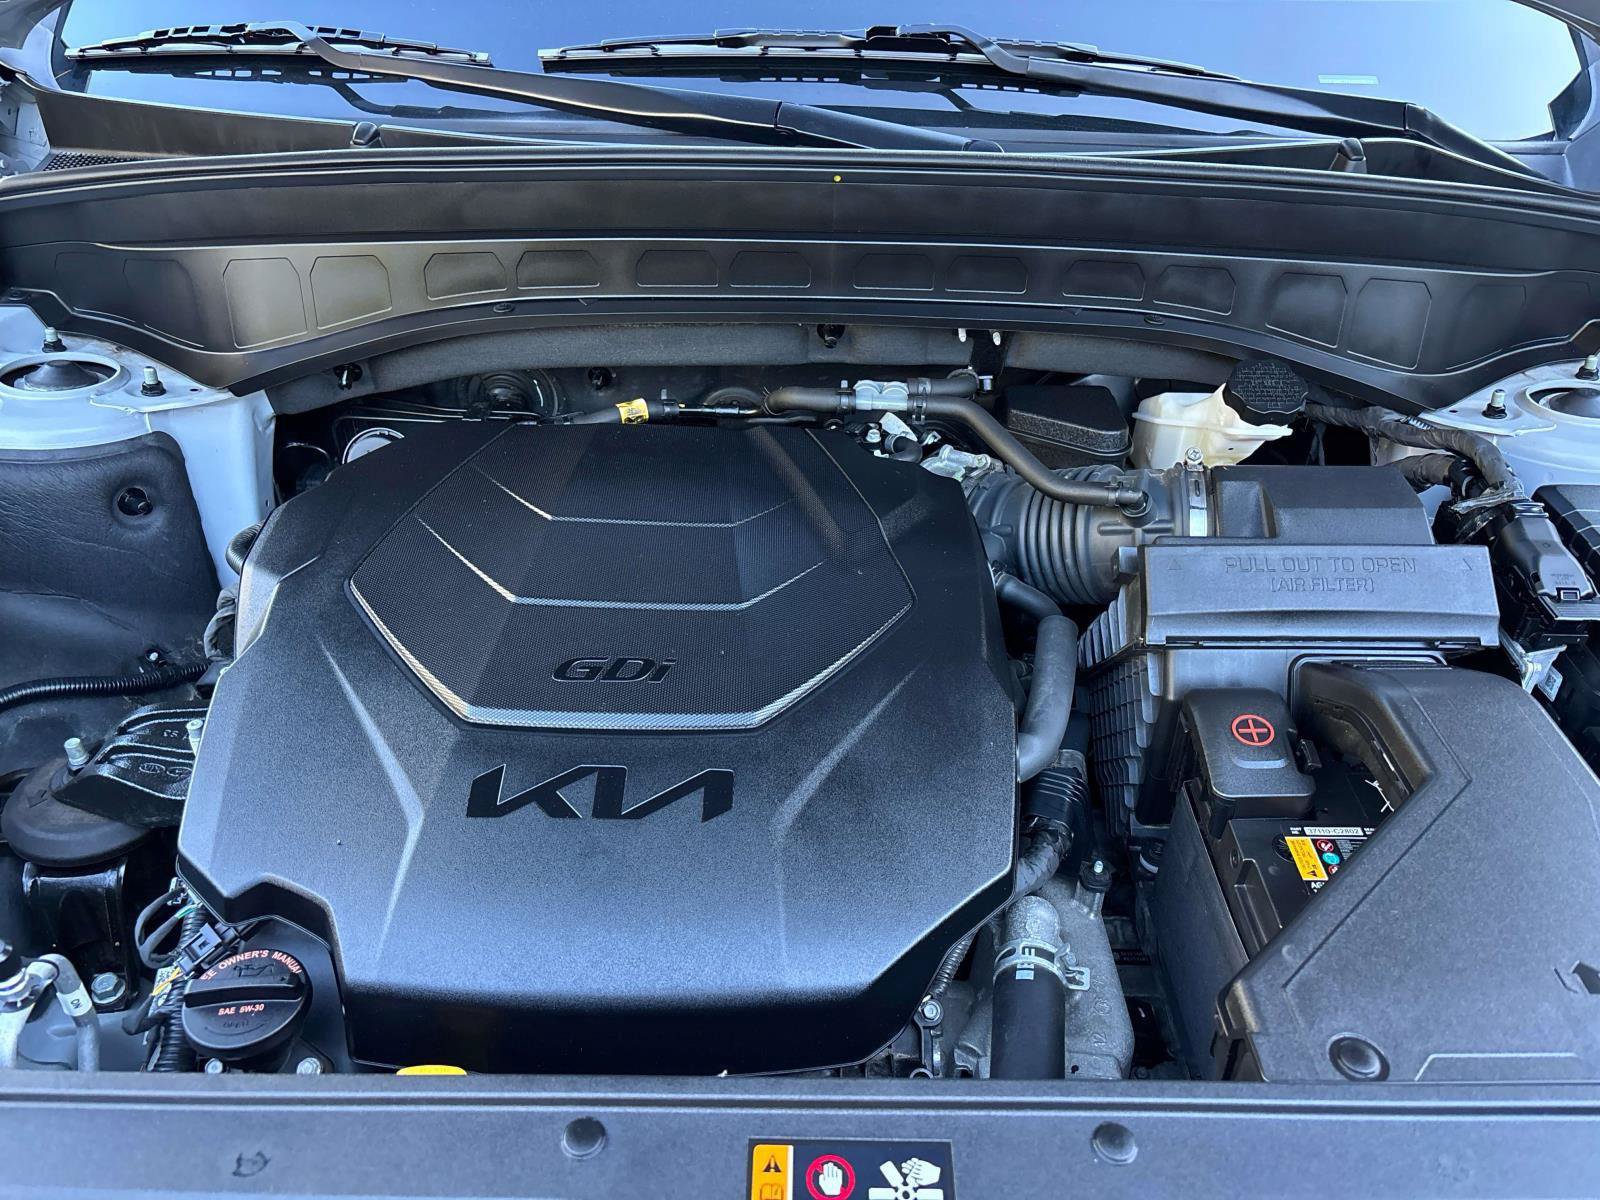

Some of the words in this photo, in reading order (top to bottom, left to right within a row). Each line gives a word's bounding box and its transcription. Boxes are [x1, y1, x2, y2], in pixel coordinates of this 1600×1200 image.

[1223, 556, 1277, 574] PULL
[1281, 556, 1322, 573] OUT
[1328, 556, 1355, 573] TO
[1361, 556, 1417, 573] OPEN
[551, 655, 677, 684] GDi
[218, 949, 270, 970] OWNER'S
[218, 1006, 236, 1016] SAE
[239, 1003, 265, 1014] 5W-30
